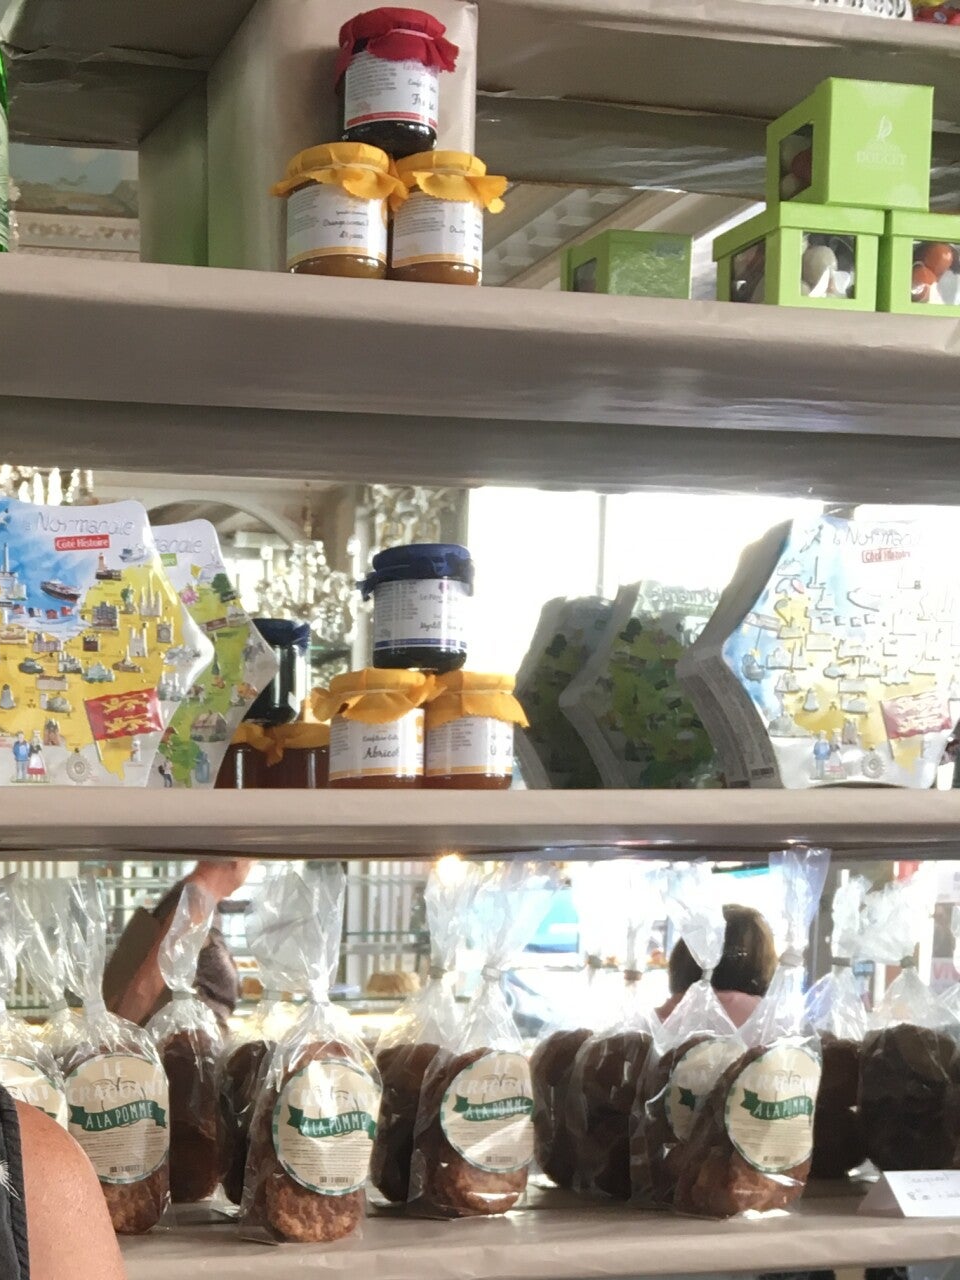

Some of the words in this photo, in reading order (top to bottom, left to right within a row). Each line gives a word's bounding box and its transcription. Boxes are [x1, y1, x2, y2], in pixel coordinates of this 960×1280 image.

[98, 1112, 112, 1128] LA
[115, 1101, 154, 1125] POMME
[329, 1113, 367, 1135] POMME
